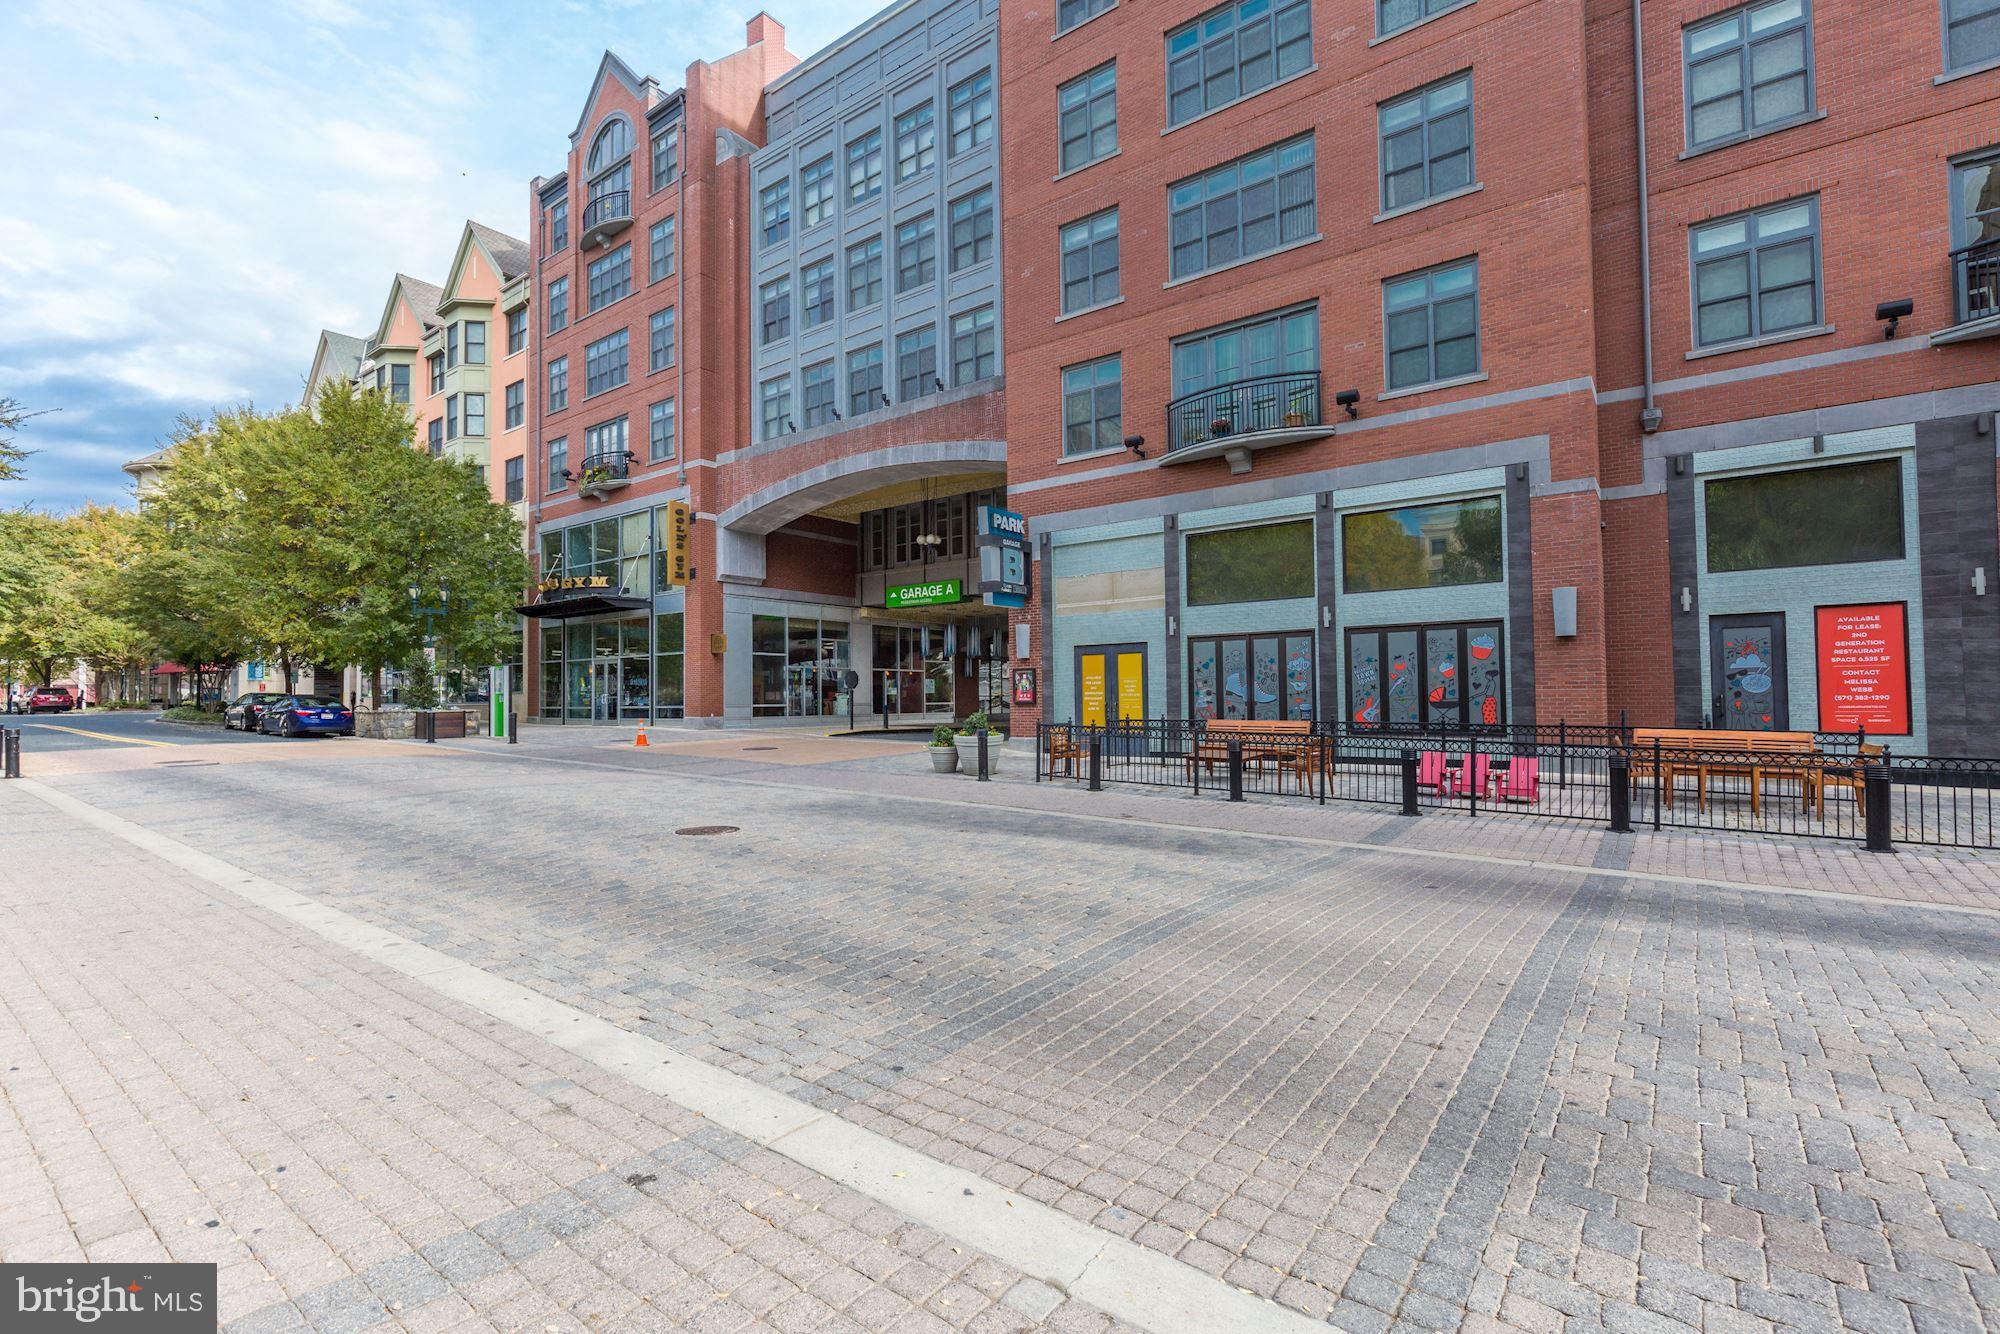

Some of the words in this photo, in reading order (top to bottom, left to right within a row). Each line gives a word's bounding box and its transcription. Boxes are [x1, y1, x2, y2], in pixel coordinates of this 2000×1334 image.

[993, 513, 1025, 534] PARK
[1003, 547, 1025, 586] B
[900, 585, 943, 599] GARAGE
[945, 583, 954, 595] A
